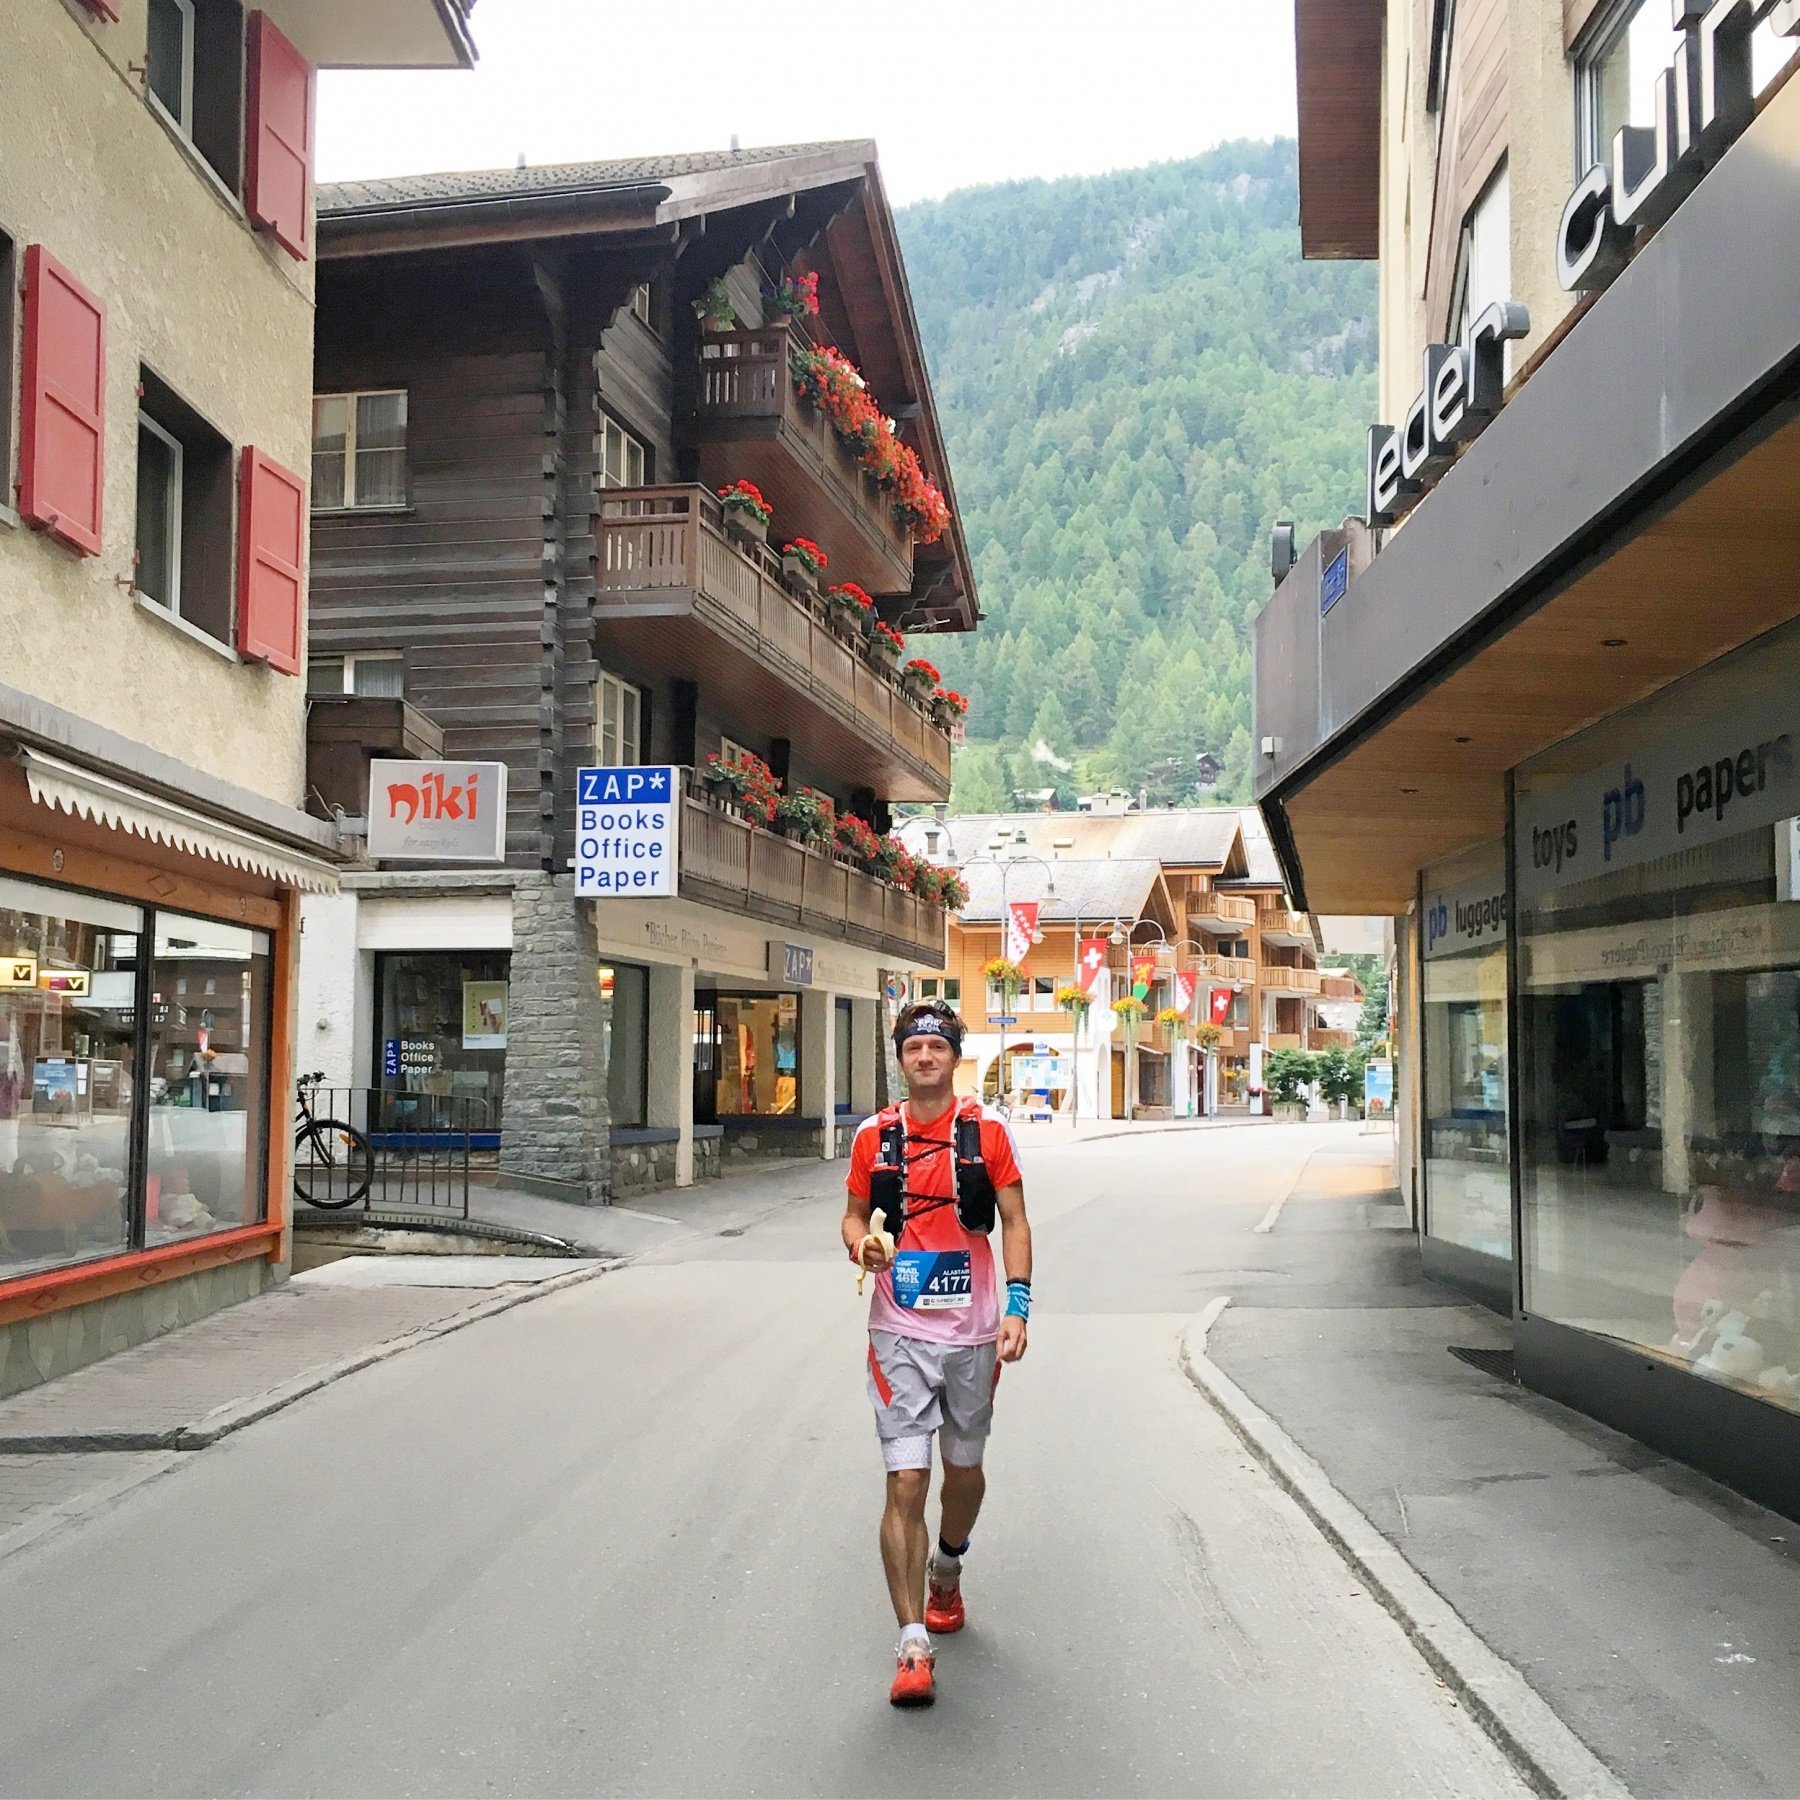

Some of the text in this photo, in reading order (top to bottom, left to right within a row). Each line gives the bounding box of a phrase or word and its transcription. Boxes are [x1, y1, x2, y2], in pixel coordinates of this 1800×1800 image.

[1366, 302, 1530, 528] leder
[387, 772, 478, 825] niki
[581, 809, 665, 830] Books
[1532, 819, 1578, 874] toys
[1603, 763, 1646, 862] pb
[580, 838, 663, 859] Office
[580, 866, 660, 892] Paper
[1428, 891, 1506, 950] pb luggage
[401, 1041, 435, 1050] Books
[400, 1052, 434, 1062] Office
[400, 1064, 433, 1075] Paper
[895, 1273, 920, 1284] 46K
[942, 1268, 970, 1276] ALASTAIR
[928, 1275, 970, 1292] 4177
